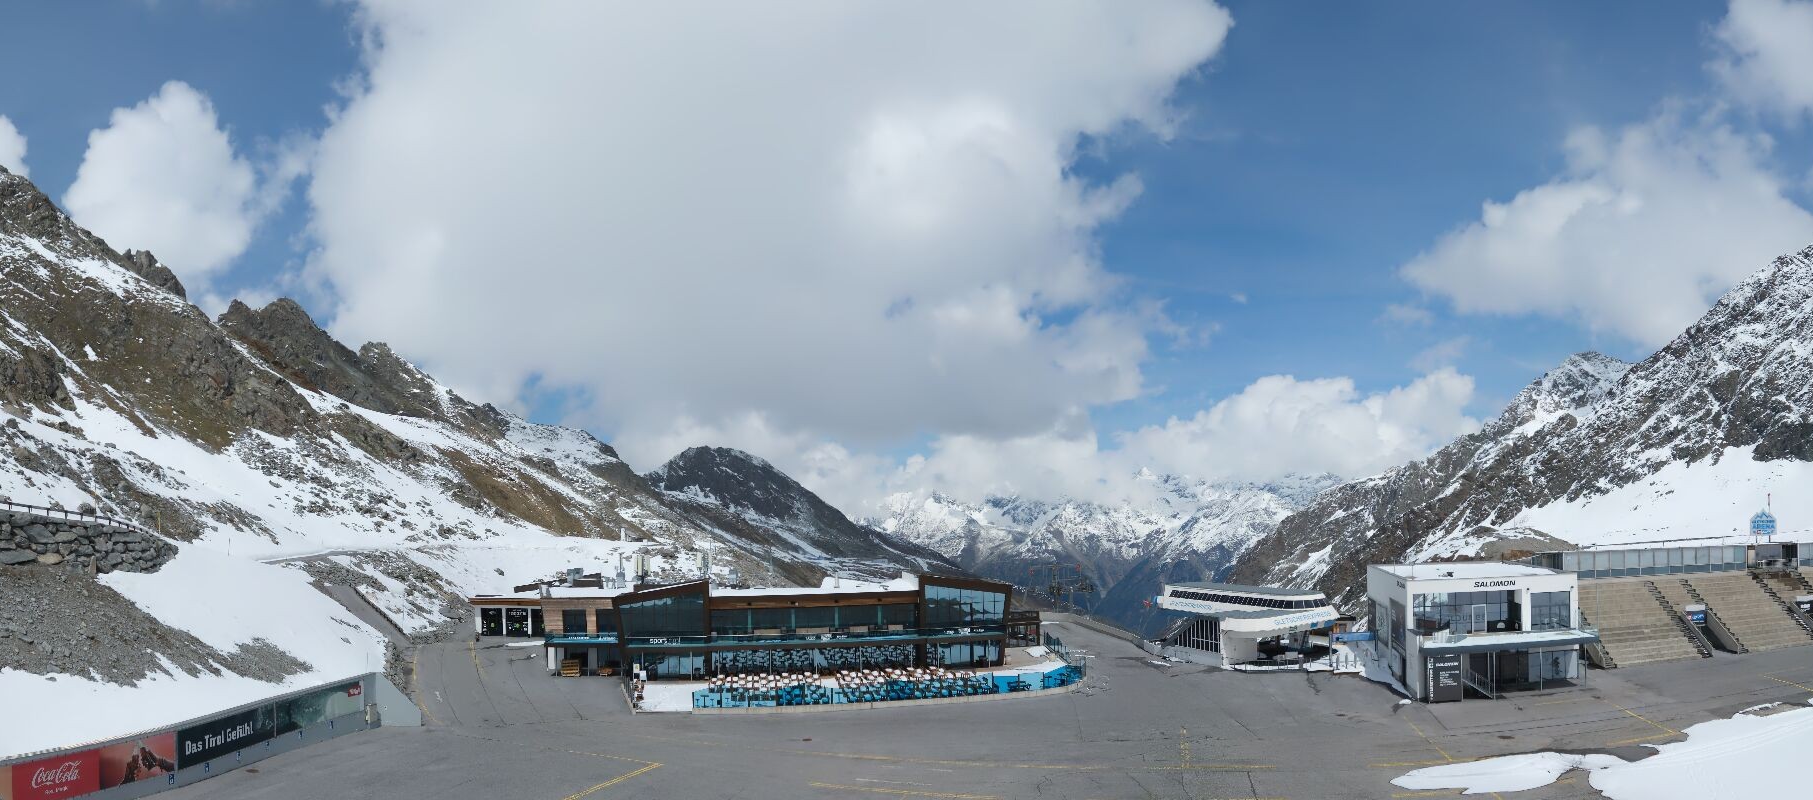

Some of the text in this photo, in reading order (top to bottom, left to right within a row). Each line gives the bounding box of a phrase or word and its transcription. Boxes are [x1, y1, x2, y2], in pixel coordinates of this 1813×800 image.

[1473, 580, 1516, 588] SALOMON
[185, 721, 254, 756] Das Tirol Gefühl
